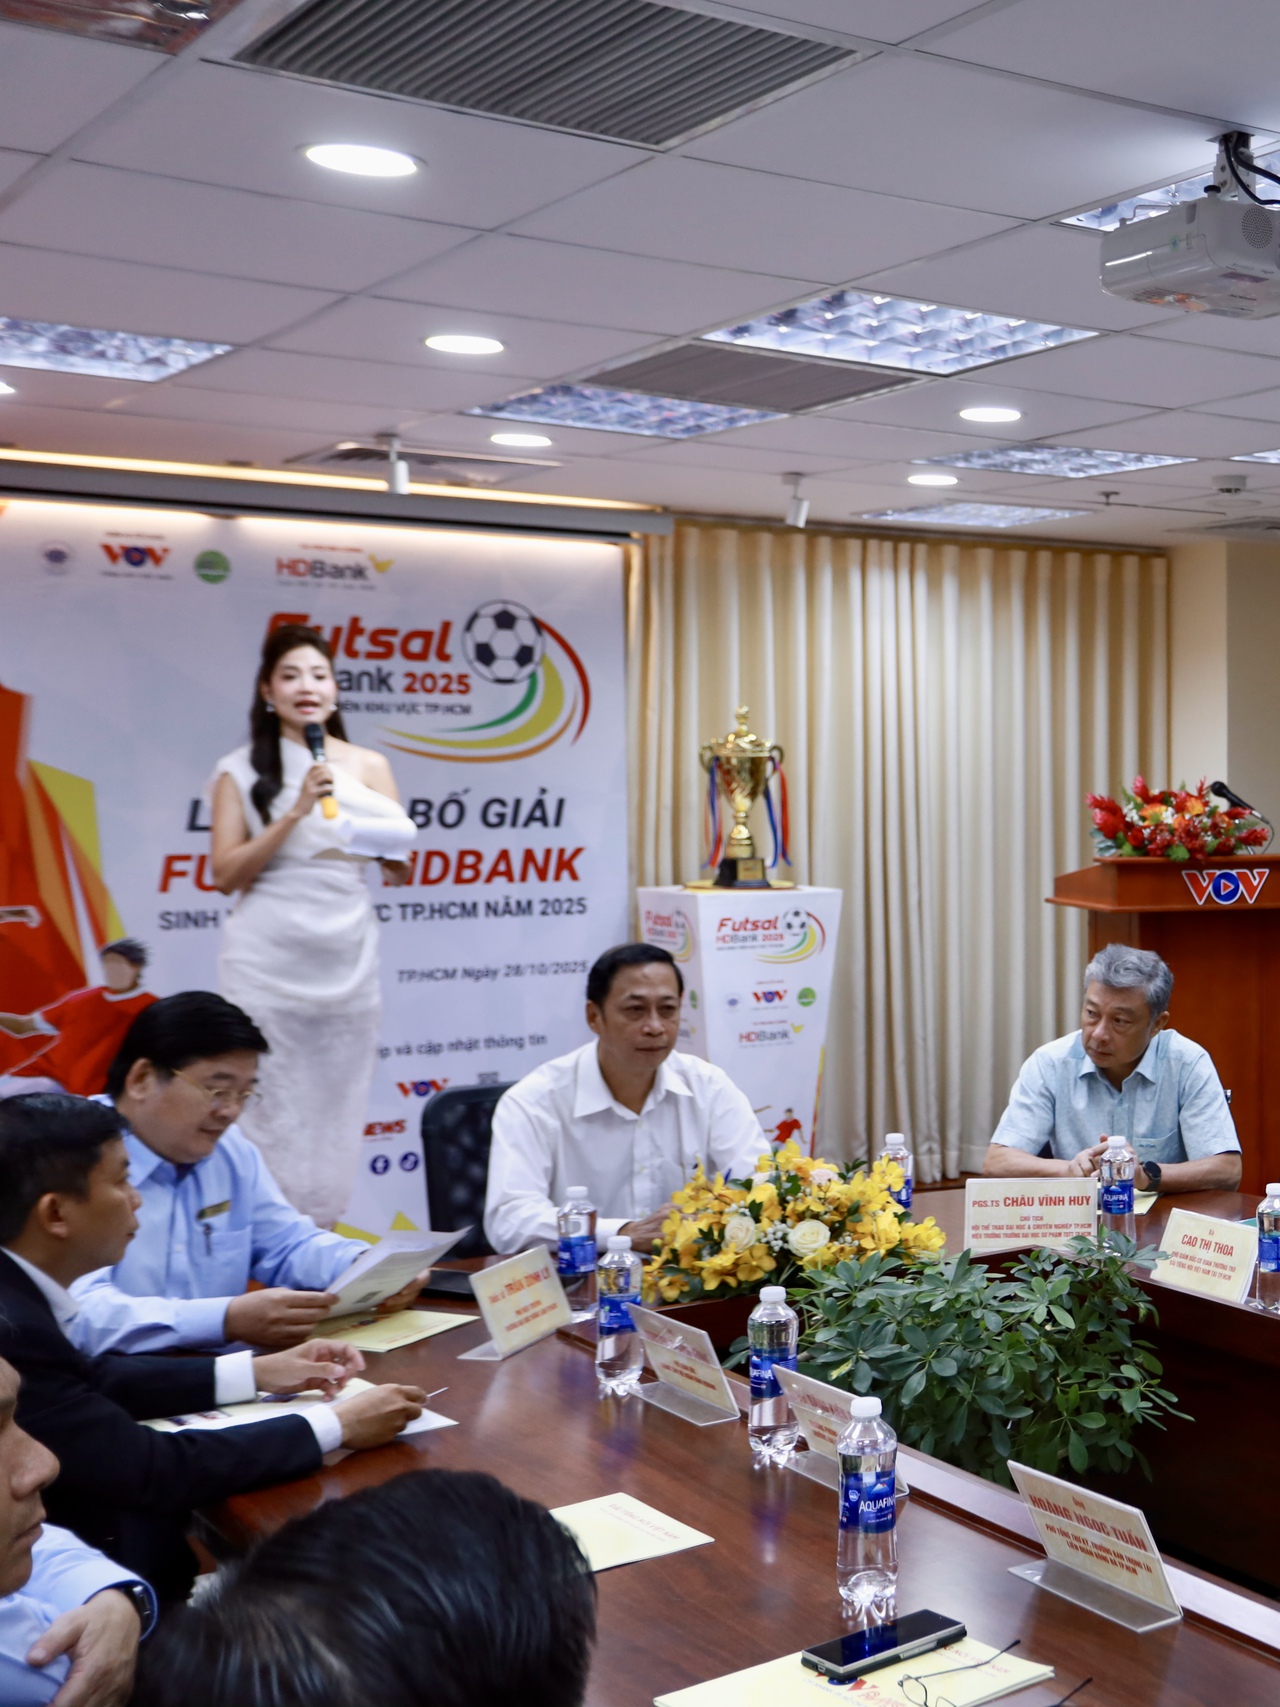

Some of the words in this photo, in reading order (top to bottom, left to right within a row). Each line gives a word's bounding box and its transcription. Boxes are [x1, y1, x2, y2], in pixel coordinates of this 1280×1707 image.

[101, 543, 170, 568] VOV
[276, 557, 369, 581] HDBank
[403, 671, 471, 695] 2025
[480, 787, 566, 829] GIẢI
[1182, 869, 1270, 905] VOV
[159, 911, 219, 930] SINH
[399, 902, 480, 922] TP.HCM
[485, 896, 534, 917] NĂM
[540, 897, 588, 916] 2025
[717, 916, 779, 932] Futsal
[462, 965, 499, 982] Ngày
[504, 960, 589, 977] 28/10/2025
[753, 990, 787, 1003] VOV
[529, 1034, 547, 1046] tin
[739, 1031, 790, 1043] HDBank
[396, 1079, 448, 1096] VOV
[972, 1200, 1000, 1208] PGS.TS
[1003, 1194, 1034, 1207] CHÂU
[1038, 1194, 1065, 1206] VĨNH
[1068, 1195, 1091, 1206] HUY
[1181, 1234, 1198, 1247] CAO
[1199, 1238, 1212, 1253] THỊ
[1213, 1241, 1234, 1257] THOA
[859, 1494, 896, 1514] AQUAFIN
[1029, 1494, 1073, 1521] HOÀNG
[1073, 1511, 1110, 1536] NGỌC
[1110, 1525, 1148, 1552] TUẤN
